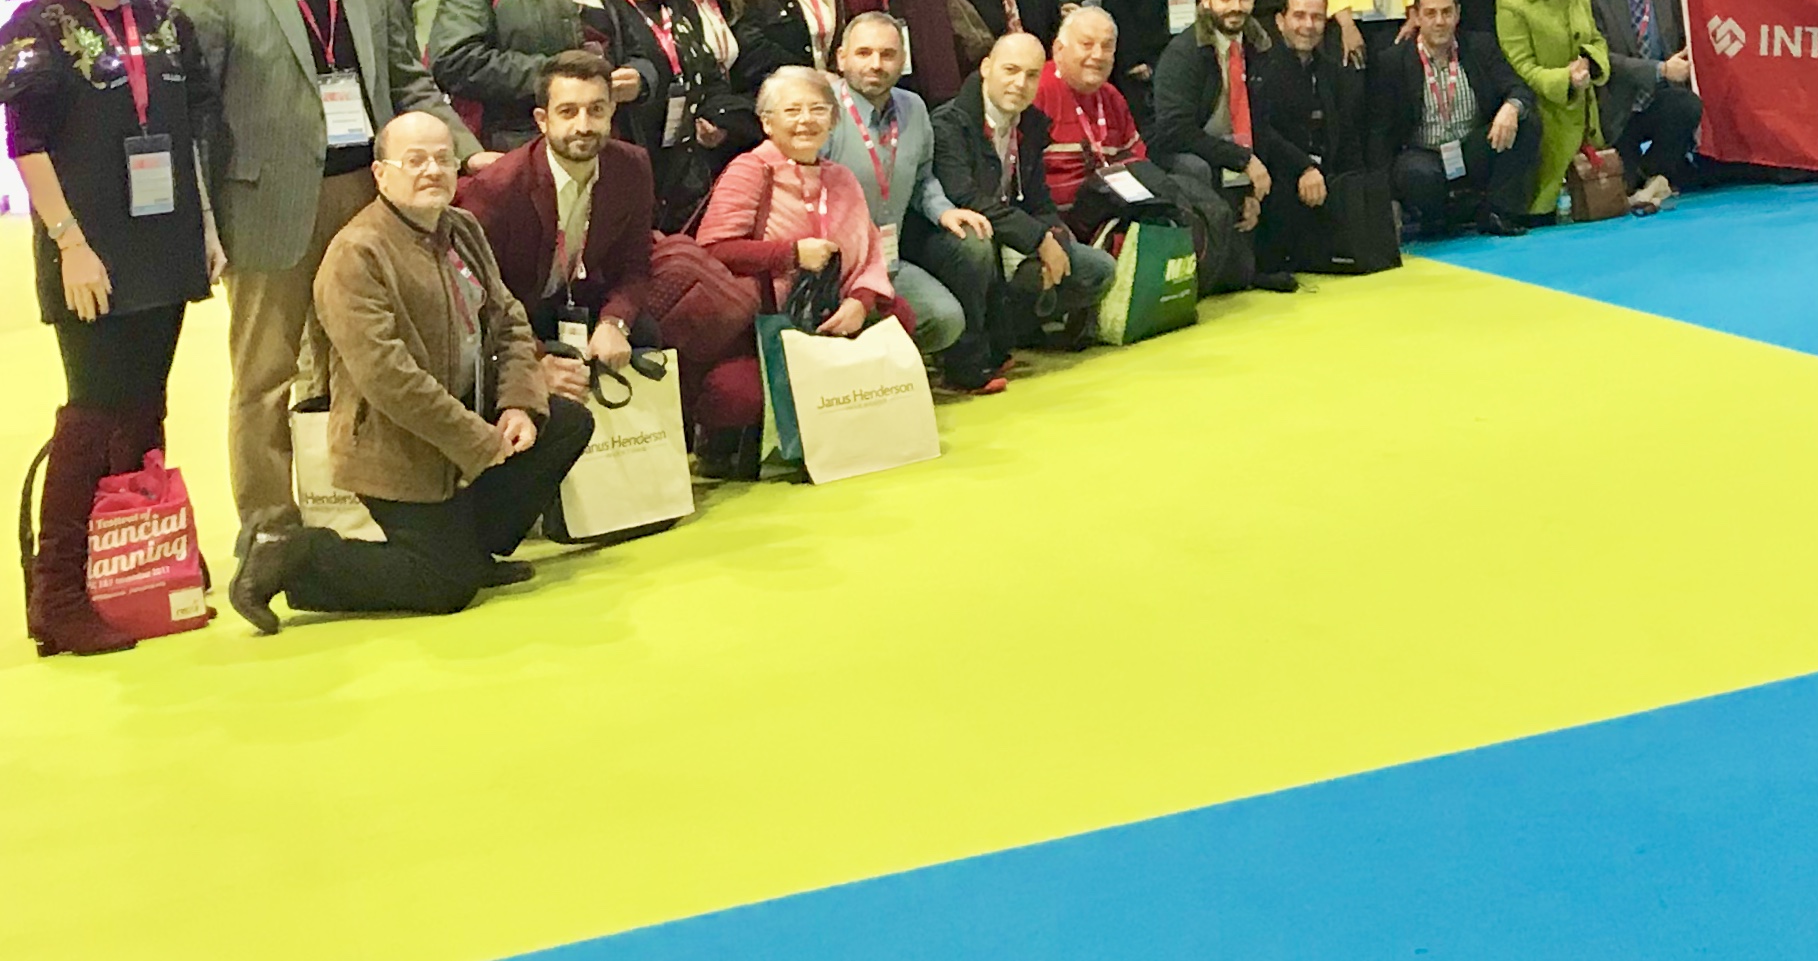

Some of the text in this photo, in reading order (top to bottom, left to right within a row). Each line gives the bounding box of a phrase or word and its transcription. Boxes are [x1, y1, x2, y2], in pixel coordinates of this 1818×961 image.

[817, 395, 851, 410] Janus
[852, 382, 914, 402] Henderson
[584, 441, 609, 455] anus
[88, 507, 188, 552] nancial
[87, 534, 188, 580] lanning
